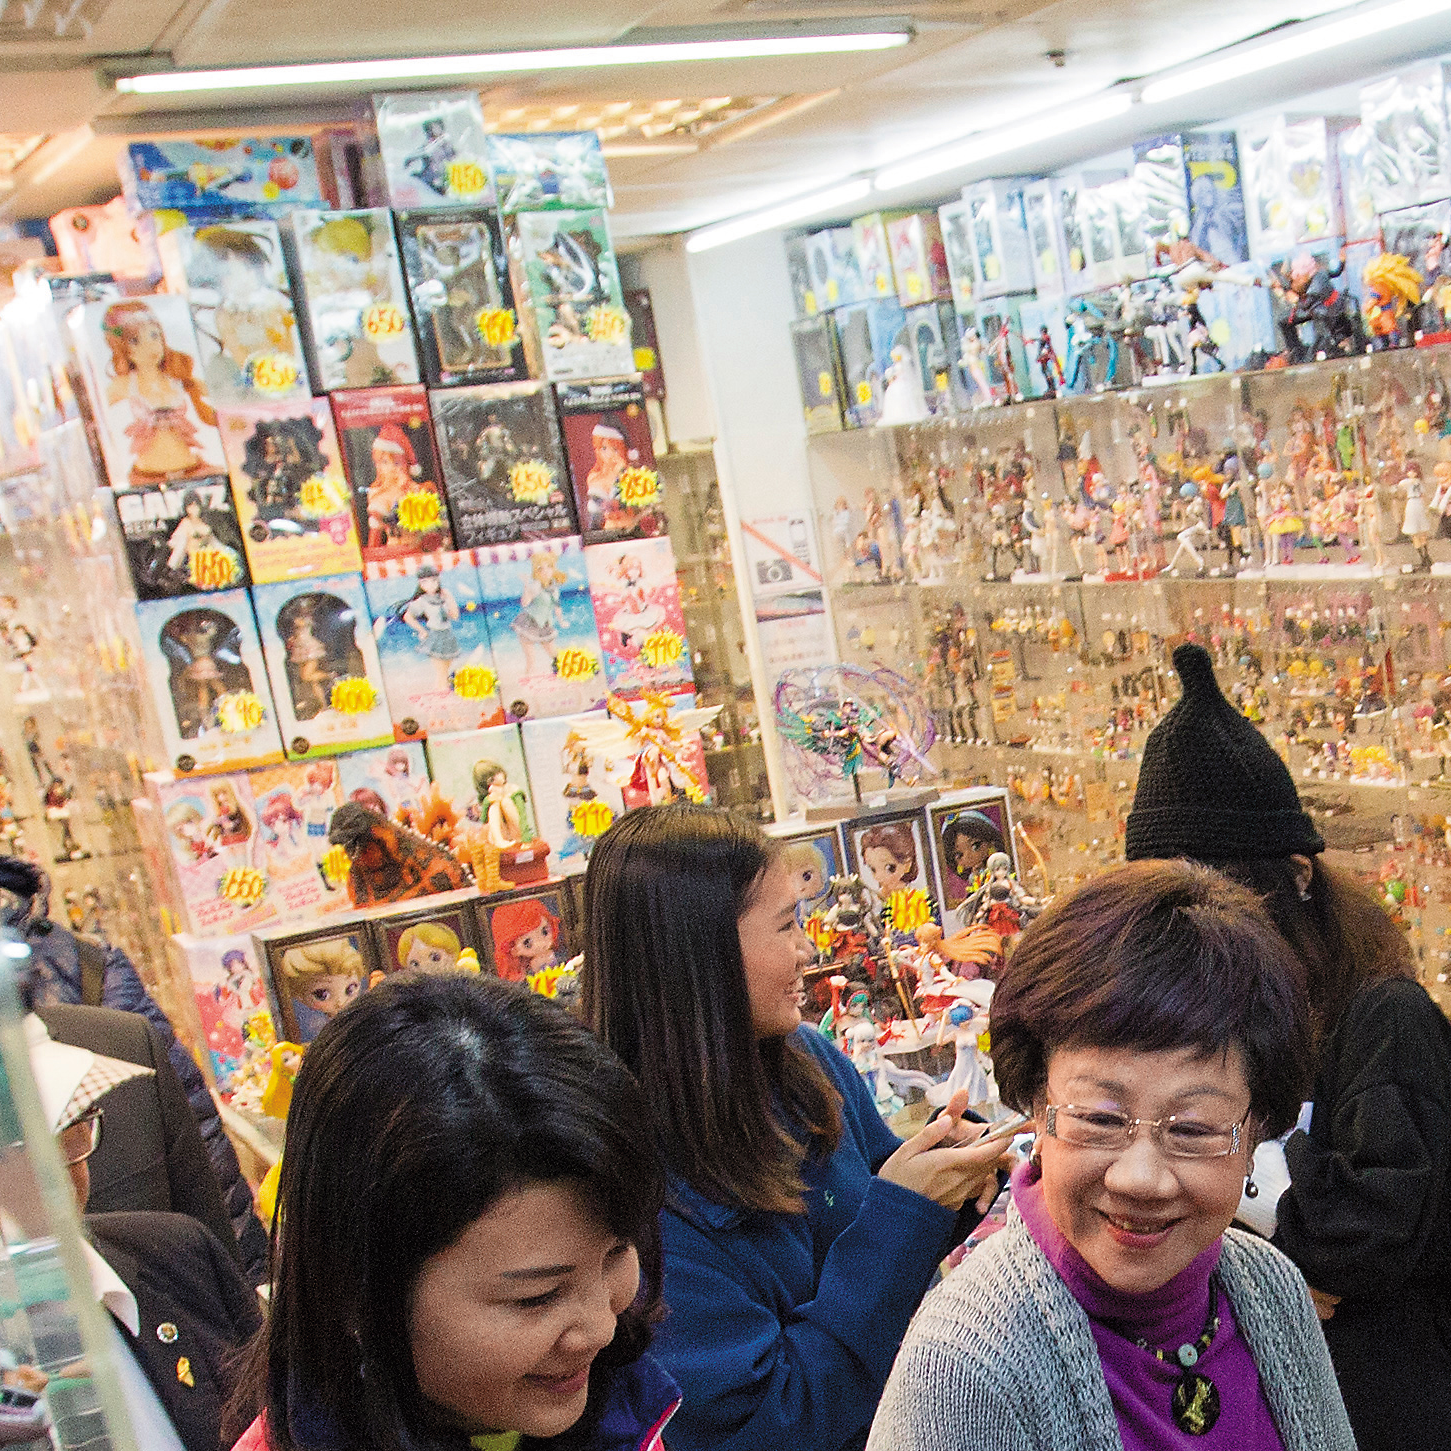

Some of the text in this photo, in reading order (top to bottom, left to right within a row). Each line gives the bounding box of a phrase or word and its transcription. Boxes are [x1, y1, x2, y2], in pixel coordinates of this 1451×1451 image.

[367, 309, 405, 335] 650
[255, 358, 297, 388] 650
[117, 484, 231, 524] GANZ
[561, 651, 590, 678] 650
[645, 636, 681, 668] 990
[574, 804, 614, 835] 990
